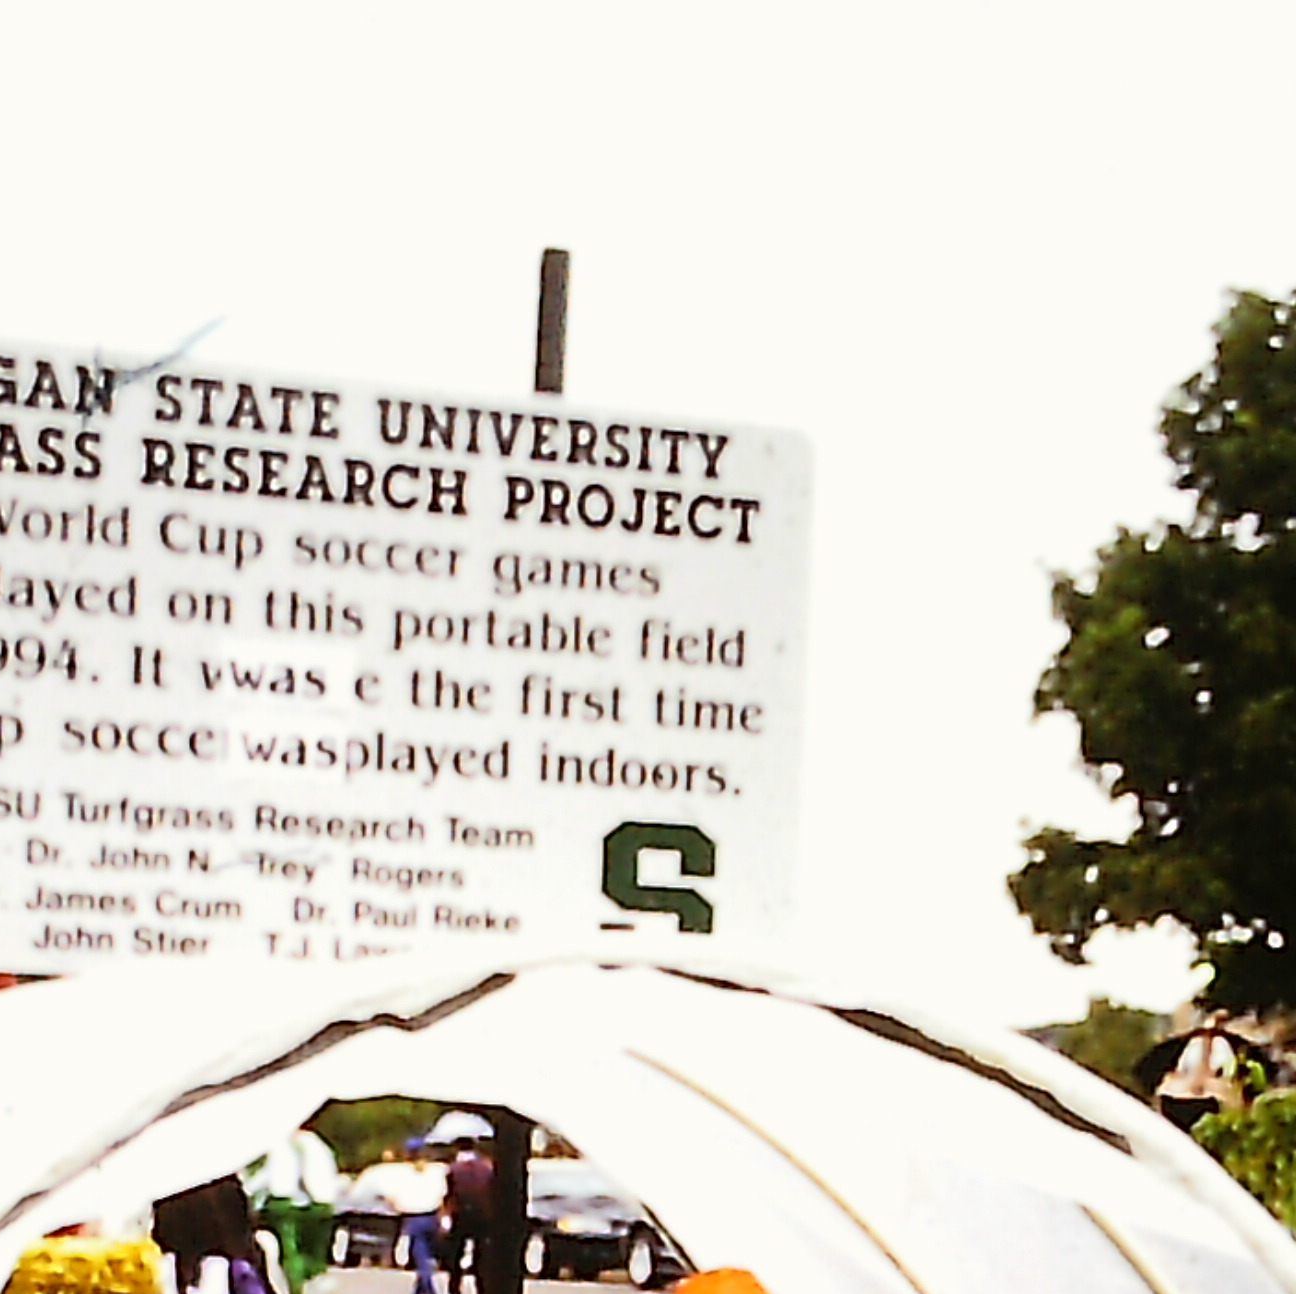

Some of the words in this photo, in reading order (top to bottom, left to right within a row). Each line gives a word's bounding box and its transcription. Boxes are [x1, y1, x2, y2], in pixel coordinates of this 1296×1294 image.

[154, 375, 341, 438] STATE
[377, 399, 729, 479] UNIVERSITY
[140, 437, 468, 516] RESEARCH
[504, 476, 761, 544] PROJECT
[159, 513, 264, 571] Cup
[295, 530, 463, 578] soccer
[492, 551, 663, 597] games
[167, 589, 233, 626] on
[265, 589, 365, 636] this
[392, 608, 614, 658] portable
[640, 619, 747, 669] field
[132, 645, 164, 687] It
[410, 668, 493, 713] the
[520, 674, 626, 724] first
[656, 686, 765, 735] time
[539, 741, 743, 796] indoors.
[62, 791, 236, 833] Turfgrass
[254, 803, 427, 844] Research
[448, 816, 536, 850] Team
[90, 843, 171, 874] John
[351, 859, 466, 892] Rogers
[24, 884, 137, 918] James
[154, 887, 242, 920] Crum
[352, 900, 418, 931] Paul
[33, 923, 114, 952] John
[133, 926, 212, 957] Stier
